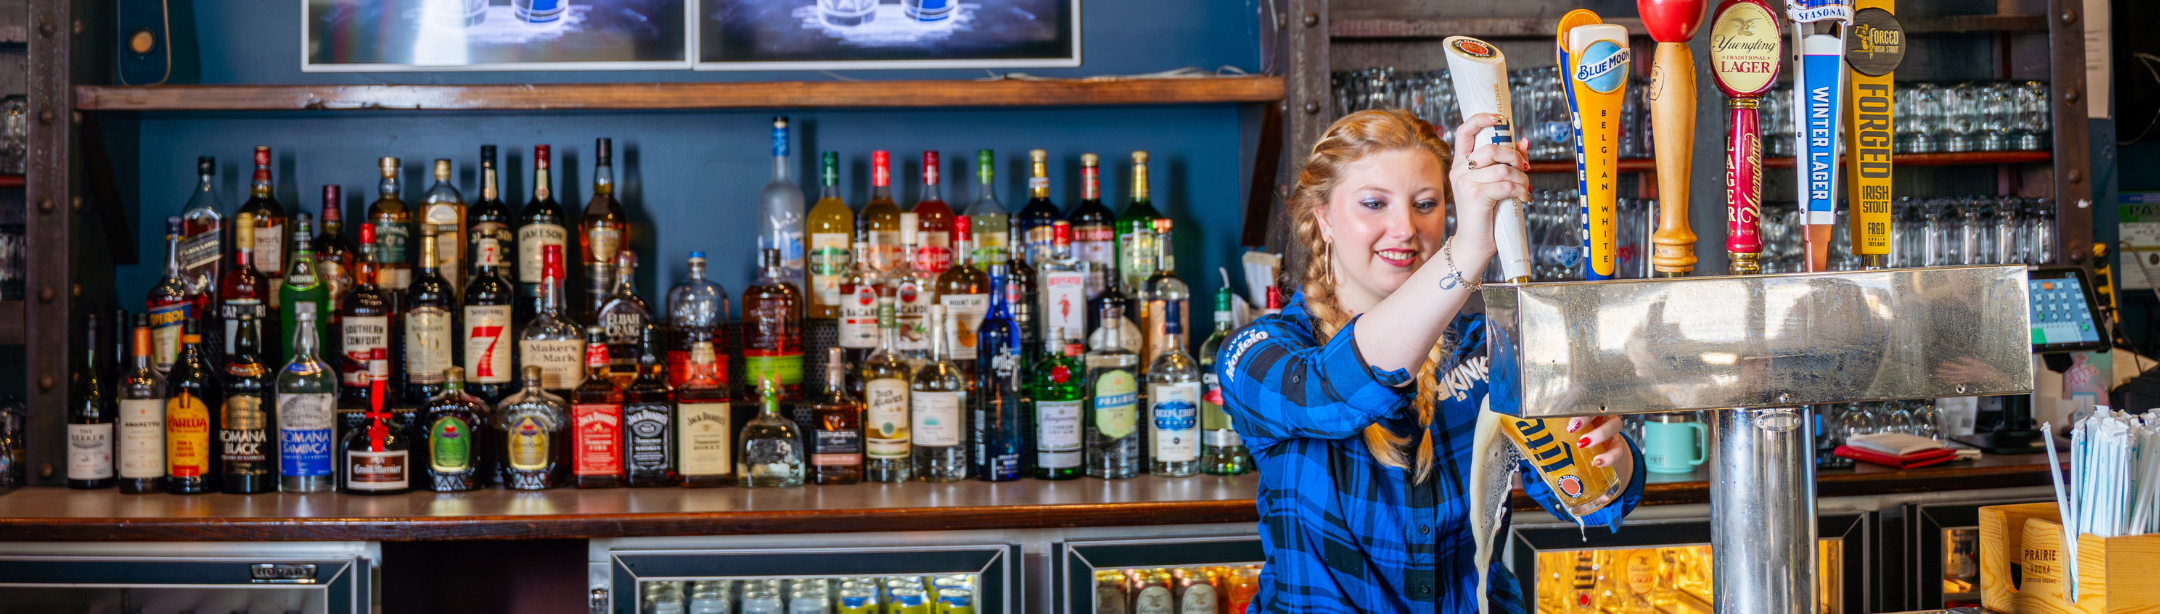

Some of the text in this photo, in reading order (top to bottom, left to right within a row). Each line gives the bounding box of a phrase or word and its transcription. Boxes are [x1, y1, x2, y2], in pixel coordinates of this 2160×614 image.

[1798, 8, 1847, 20] SEASONAL
[1712, 34, 1776, 53] Yuengling
[1869, 27, 1899, 59] FORGED
[1874, 45, 1899, 53] IRISH STOUT
[1577, 51, 1630, 80] BLUE MOON
[1721, 61, 1771, 73] LAGER
[1494, 83, 1503, 113] PILSNER
[1858, 84, 1891, 179] FORGED
[1812, 86, 1830, 200] WINTER LAGER
[1726, 136, 1737, 222] LAGER
[1741, 132, 1762, 224] Yuengling
[1862, 185, 1889, 200] IRISH
[1862, 201, 1889, 213] STOUT
[522, 228, 564, 241] JAMESON
[1601, 206, 1609, 263] WHITE
[1868, 222, 1885, 235] FRGD
[471, 230, 513, 243] JASON
[484, 247, 494, 263] 7
[289, 274, 316, 284] MIDORI
[1048, 276, 1082, 287] BEEFEATER
[846, 308, 877, 317] BACAR
[606, 314, 640, 325] ELIJAH
[345, 324, 384, 335] SOUTHERN
[605, 324, 640, 337] CRAIG
[346, 335, 382, 346] COMFORT
[470, 326, 505, 377] 7
[530, 343, 577, 352] Maker's
[543, 353, 577, 363] Mark
[1226, 331, 1268, 383] Modelo
[1444, 354, 1489, 398] KINK
[872, 394, 904, 408] AGAVES
[1098, 393, 1137, 406] PRAIRIE
[578, 415, 593, 427] JACK
[627, 409, 668, 426] JACK DANIEL'S
[687, 415, 703, 426] JACK
[71, 433, 104, 441] SEEKER
[281, 430, 330, 442] ROMANA
[225, 443, 259, 455] BLACK
[2024, 549, 2057, 561] PRAIRIE
[2030, 564, 2050, 574] VODKA
